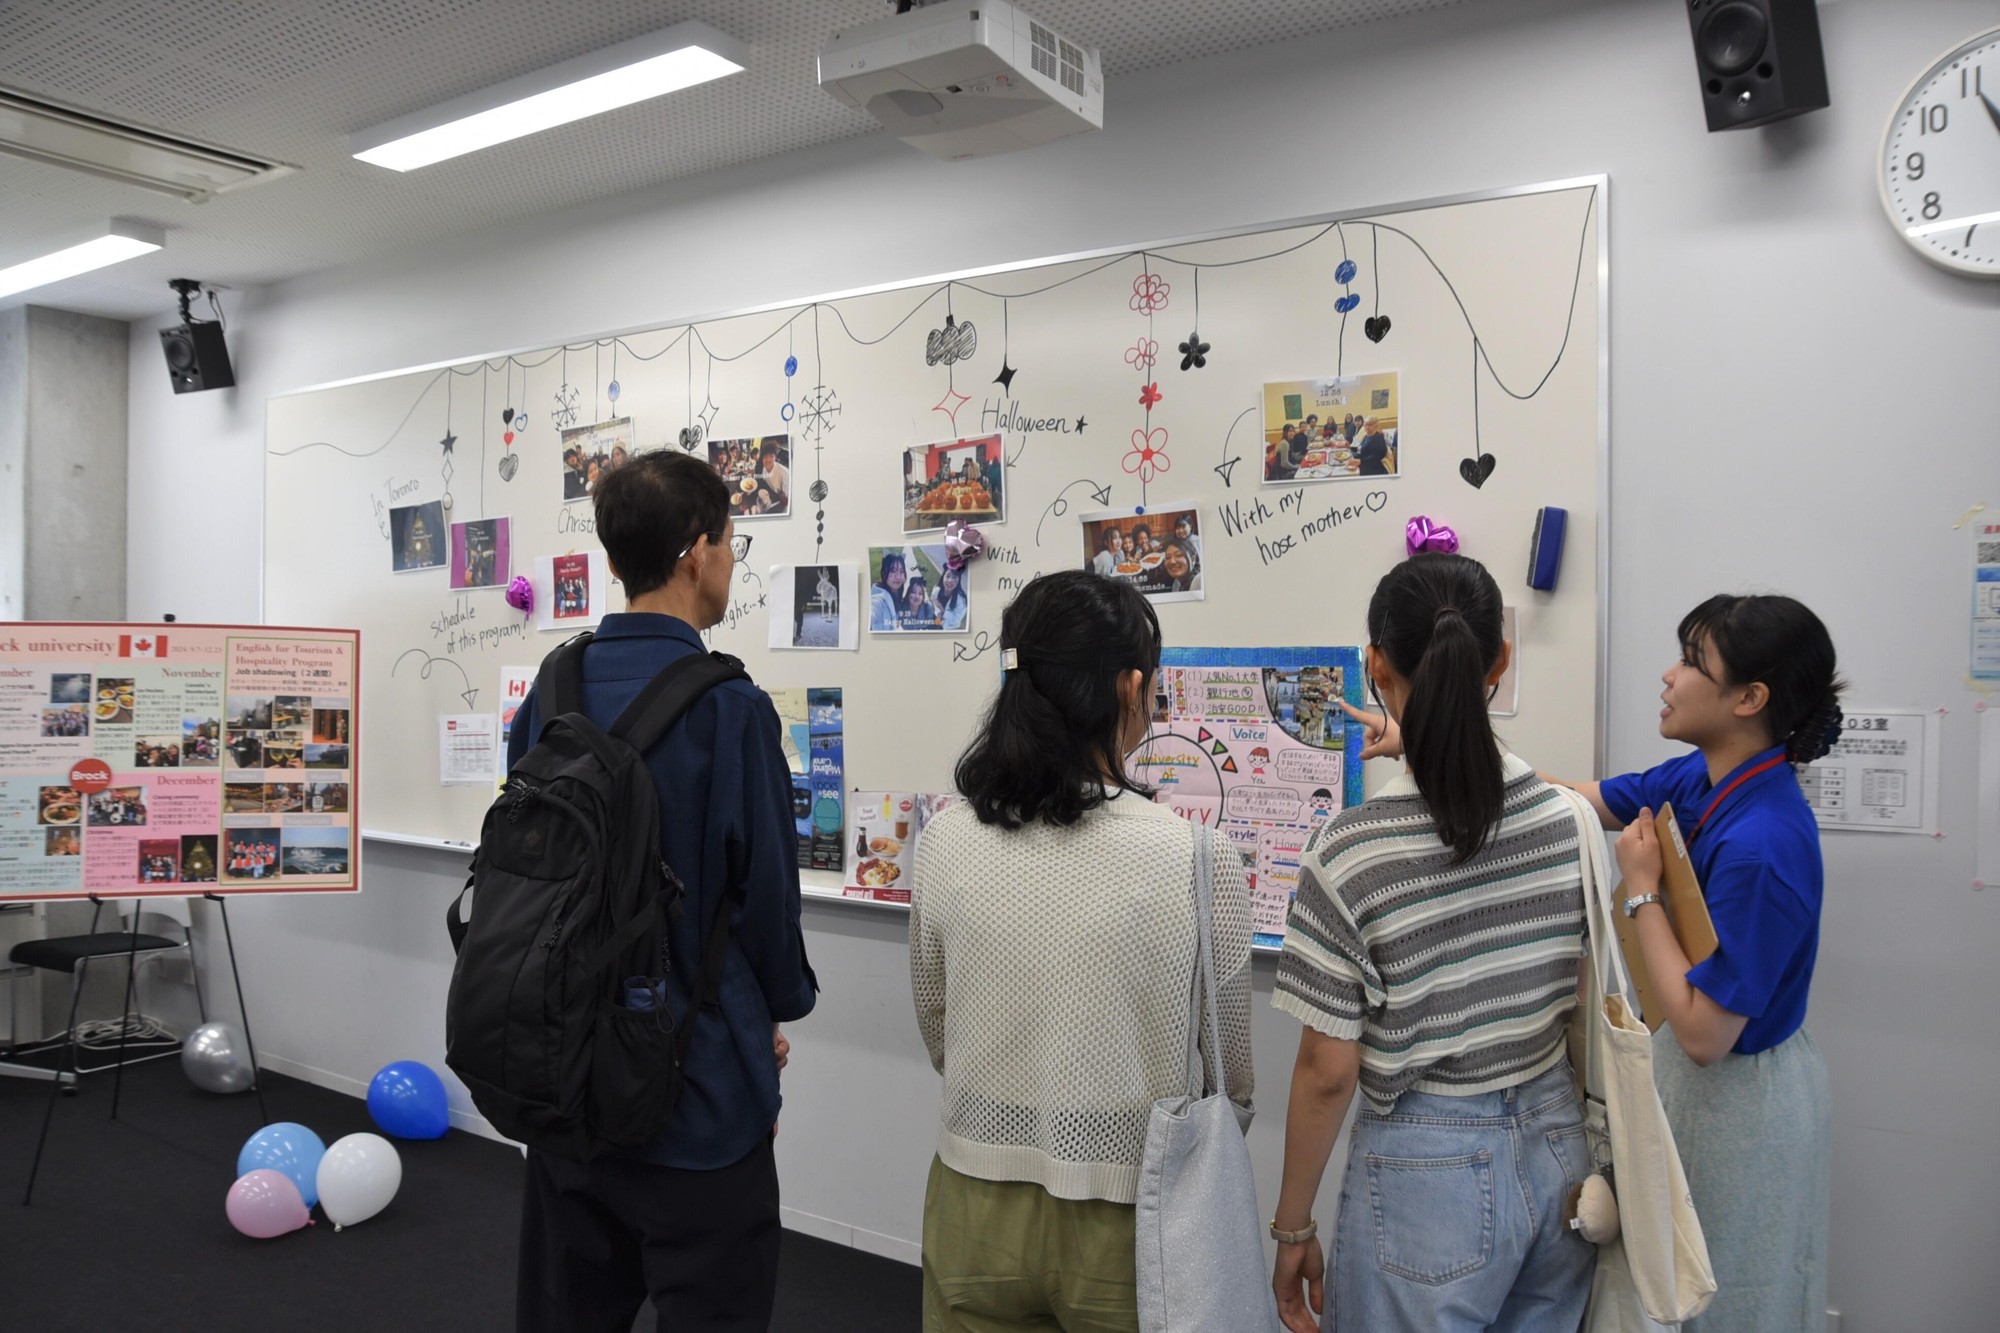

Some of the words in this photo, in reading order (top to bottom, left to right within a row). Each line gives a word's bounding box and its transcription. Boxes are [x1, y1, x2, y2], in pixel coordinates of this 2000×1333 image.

[1961, 65, 1982, 99] 11
[1921, 103, 1948, 136] 10
[1906, 152, 1925, 181] 9
[1921, 191, 1942, 220] 8
[981, 398, 1071, 434] Halloween
[1218, 497, 1274, 537] With
[1279, 488, 1304, 516] my
[1255, 534, 1297, 566] host
[1300, 506, 1364, 542] mother
[998, 576, 1024, 601] my
[431, 595, 475, 639] schedule
[447, 630, 455, 654] of
[458, 626, 477, 653] this
[479, 618, 528, 653] program!
[28, 638, 116, 656] university
[236, 643, 271, 654] English
[275, 643, 289, 653] for
[293, 645, 333, 655] Tourism
[335, 646, 344, 655] &
[162, 667, 221, 678] November
[235, 656, 288, 667] Hospitality
[292, 658, 333, 668] Program
[235, 668, 251, 676] Job
[253, 668, 297, 678] shadowing
[1174, 669, 1186, 715] POINT
[1232, 727, 1266, 740] Voice
[71, 770, 110, 781] Brock
[156, 775, 217, 786] December
[1162, 767, 1175, 781] of
[813, 781, 839, 791] LOCKS
[822, 789, 839, 799] see
